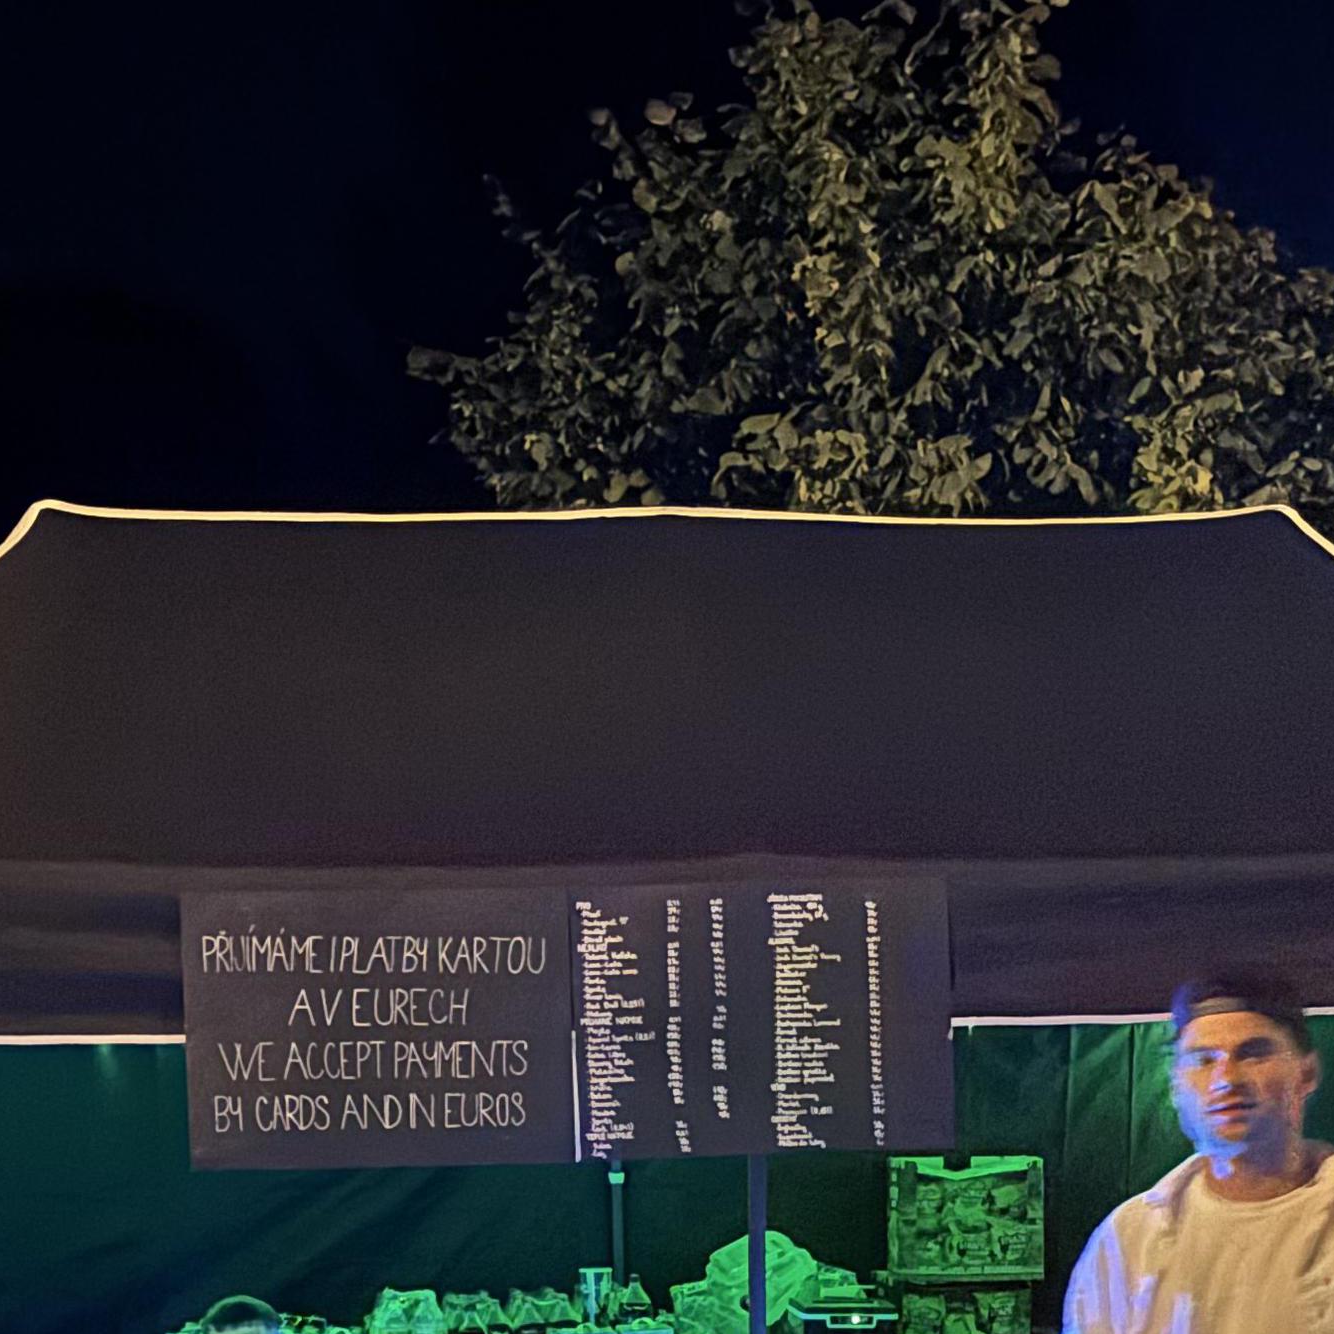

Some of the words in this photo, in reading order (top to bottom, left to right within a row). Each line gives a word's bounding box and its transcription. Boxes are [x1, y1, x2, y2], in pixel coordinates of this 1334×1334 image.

[339, 936, 428, 975] PLATBY
[439, 936, 547, 975] KARTOU
[288, 989, 316, 1027] A
[320, 989, 343, 1027] V
[352, 988, 469, 1027] EURECH
[218, 1041, 276, 1082] WE
[284, 1041, 386, 1080] ACCEPT
[394, 1040, 528, 1079] PAYMENTS
[215, 1095, 244, 1133] BY
[255, 1095, 330, 1132] CARDS
[341, 1093, 403, 1130] AND
[409, 1092, 436, 1129] IN
[444, 1092, 526, 1129] EUROS
